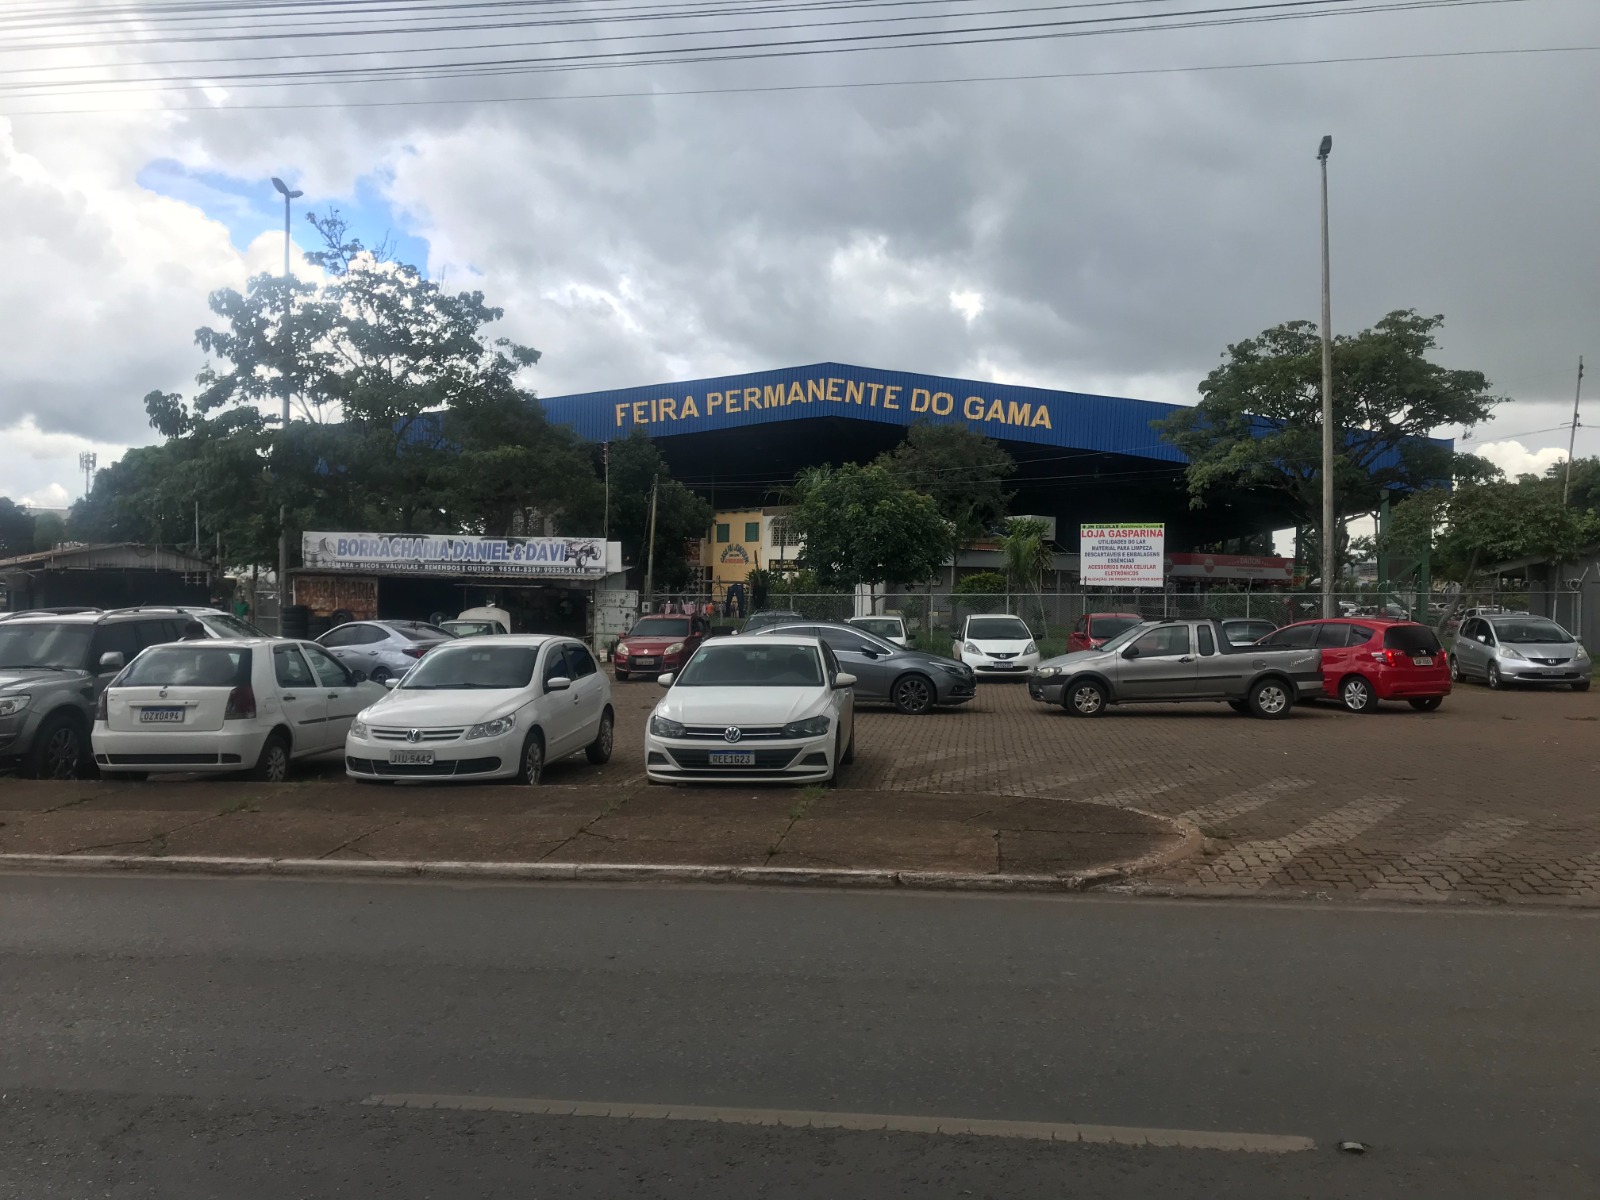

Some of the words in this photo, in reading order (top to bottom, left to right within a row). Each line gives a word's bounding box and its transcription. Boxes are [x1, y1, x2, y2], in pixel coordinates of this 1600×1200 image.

[616, 395, 699, 426] FEIRA
[707, 378, 902, 415] PERMANENTE
[910, 388, 954, 416] DO
[964, 396, 1052, 429] GAMA
[1081, 529, 1105, 538] LOJA
[1108, 529, 1163, 538] GASPARINA
[337, 538, 449, 559] BORRACHARIA
[453, 541, 508, 561] DANIEL
[513, 544, 523, 561] &
[525, 542, 566, 562] DAVI
[385, 562, 418, 570] VÁLVULAS
[713, 755, 751, 764] REE1G23
